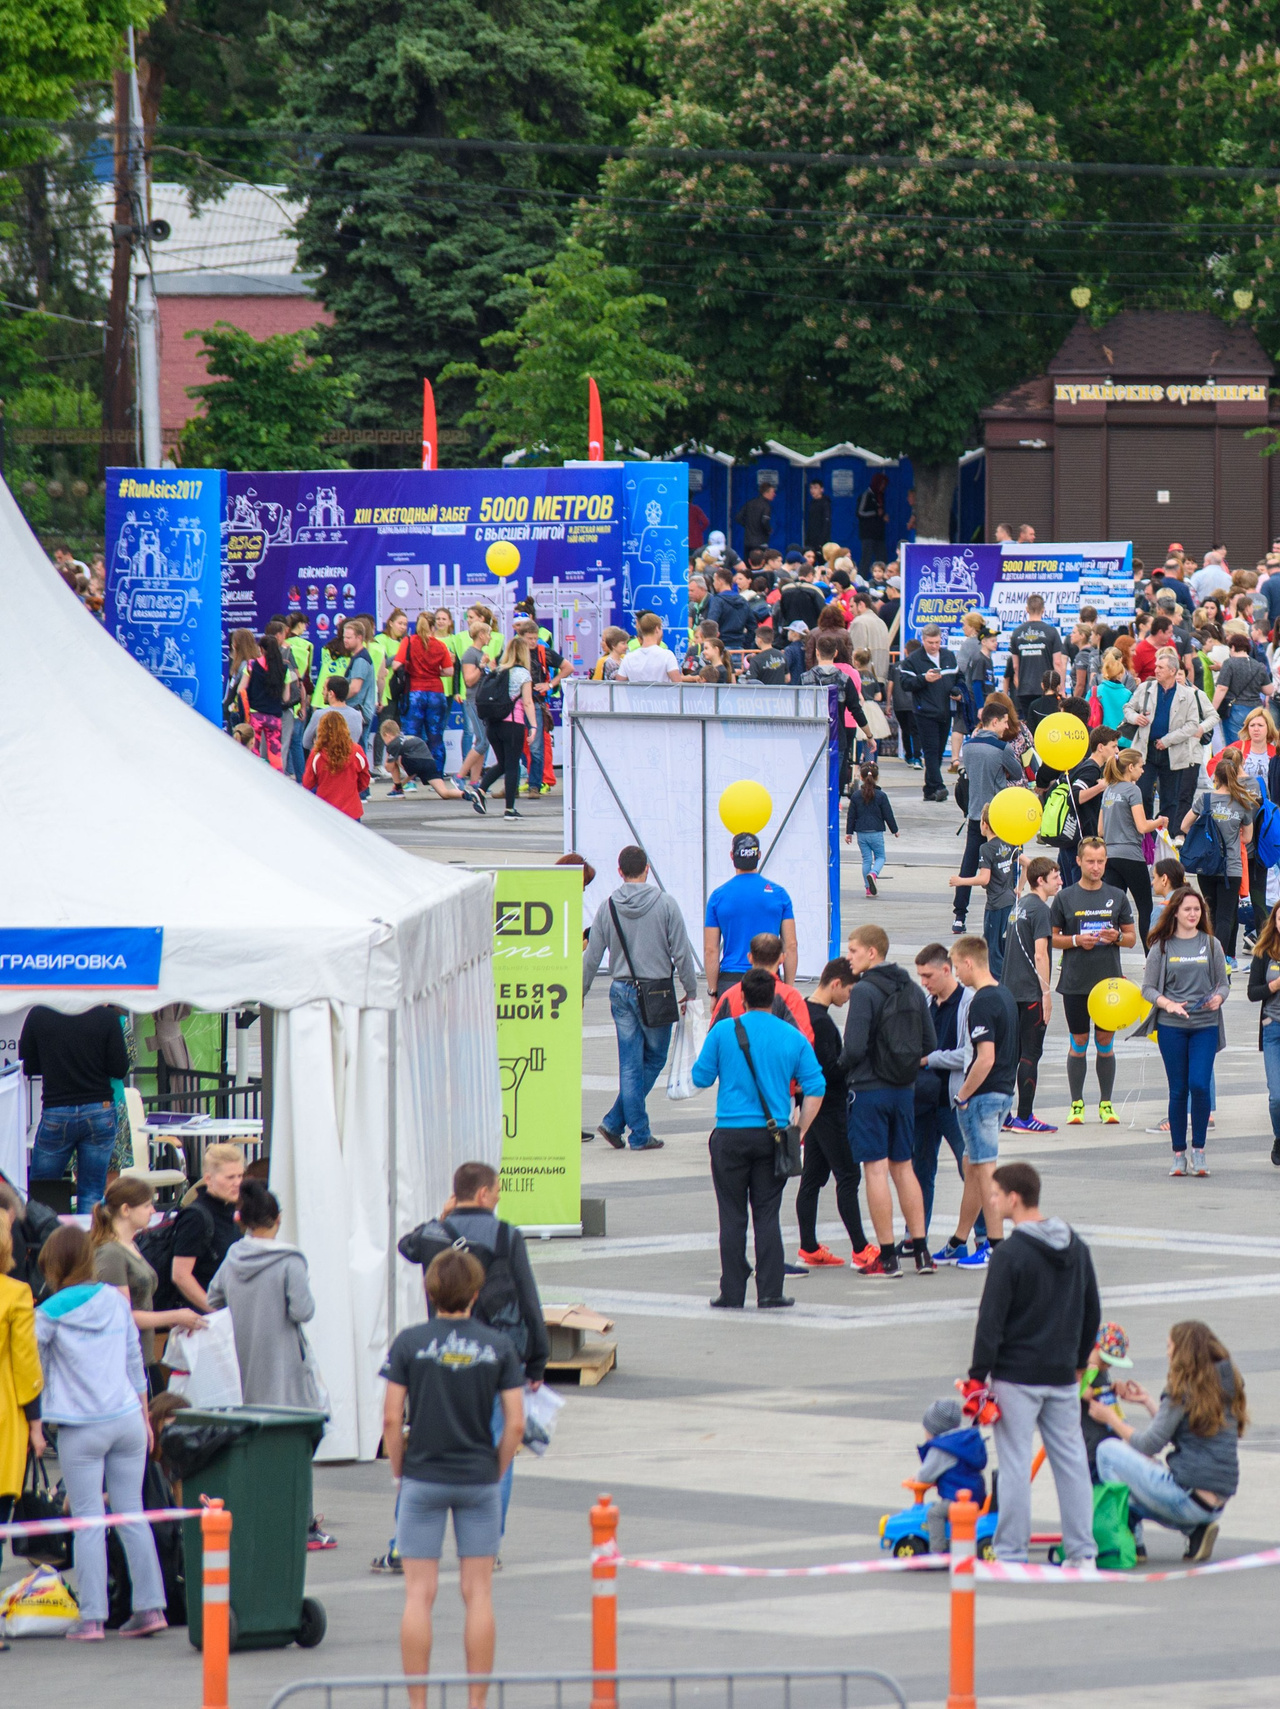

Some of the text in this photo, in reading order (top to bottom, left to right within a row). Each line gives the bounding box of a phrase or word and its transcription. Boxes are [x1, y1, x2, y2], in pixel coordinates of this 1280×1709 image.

[1055, 384, 1266, 406] КУБАНСКИЕ СУВЕНИРЫ
[118, 478, 203, 500] #RunAsics2017
[354, 503, 471, 525] XIII ЕЖЕГОДНЫЙ ЗАБЕГ
[479, 495, 614, 522] 5000 МЕТРОВ
[484, 524, 530, 541] ВЫСШЕЙ
[531, 523, 565, 540] ЛИГОЙ
[1002, 560, 1023, 572] 5000
[1024, 560, 1059, 572] МЕТРОВ
[1005, 592, 1029, 604] НАМИ
[133, 610, 180, 619] KRASNODAR 2017
[916, 614, 957, 623] KRASNODAR
[1063, 729, 1085, 740] 4:00
[1062, 813, 1077, 840] NIKE
[0, 954, 127, 970] ГРАВИРОВКА
[494, 983, 544, 999] ЕБЯ
